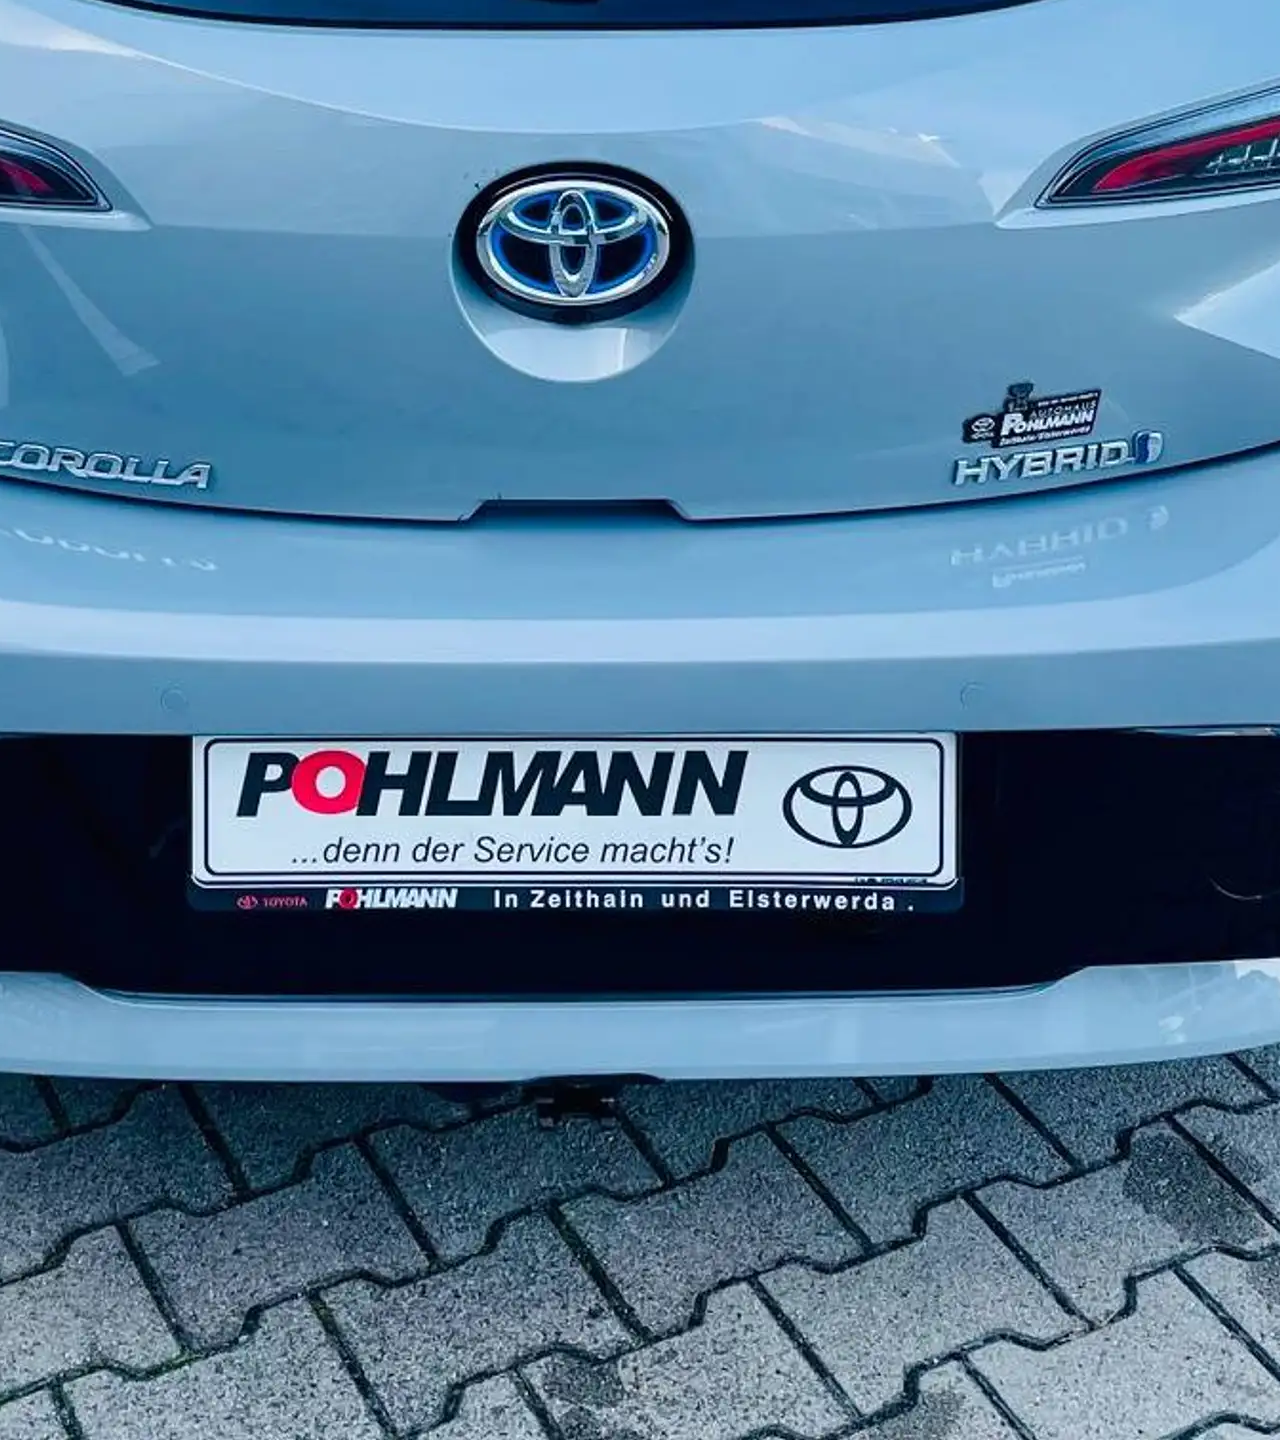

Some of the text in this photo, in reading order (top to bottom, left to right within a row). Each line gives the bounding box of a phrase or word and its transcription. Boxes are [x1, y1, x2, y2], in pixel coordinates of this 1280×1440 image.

[1000, 409, 1095, 436] POHLMANN
[954, 439, 1131, 486] HYBRID
[236, 749, 749, 818] POHLMANN
[412, 836, 465, 863] der
[473, 836, 590, 864] Service
[600, 836, 735, 864] macht's!
[262, 896, 309, 908] TOYOTA
[324, 887, 459, 910] POHLMANN
[494, 889, 518, 908] In
[531, 889, 645, 909] Zeithain
[661, 889, 711, 908] und
